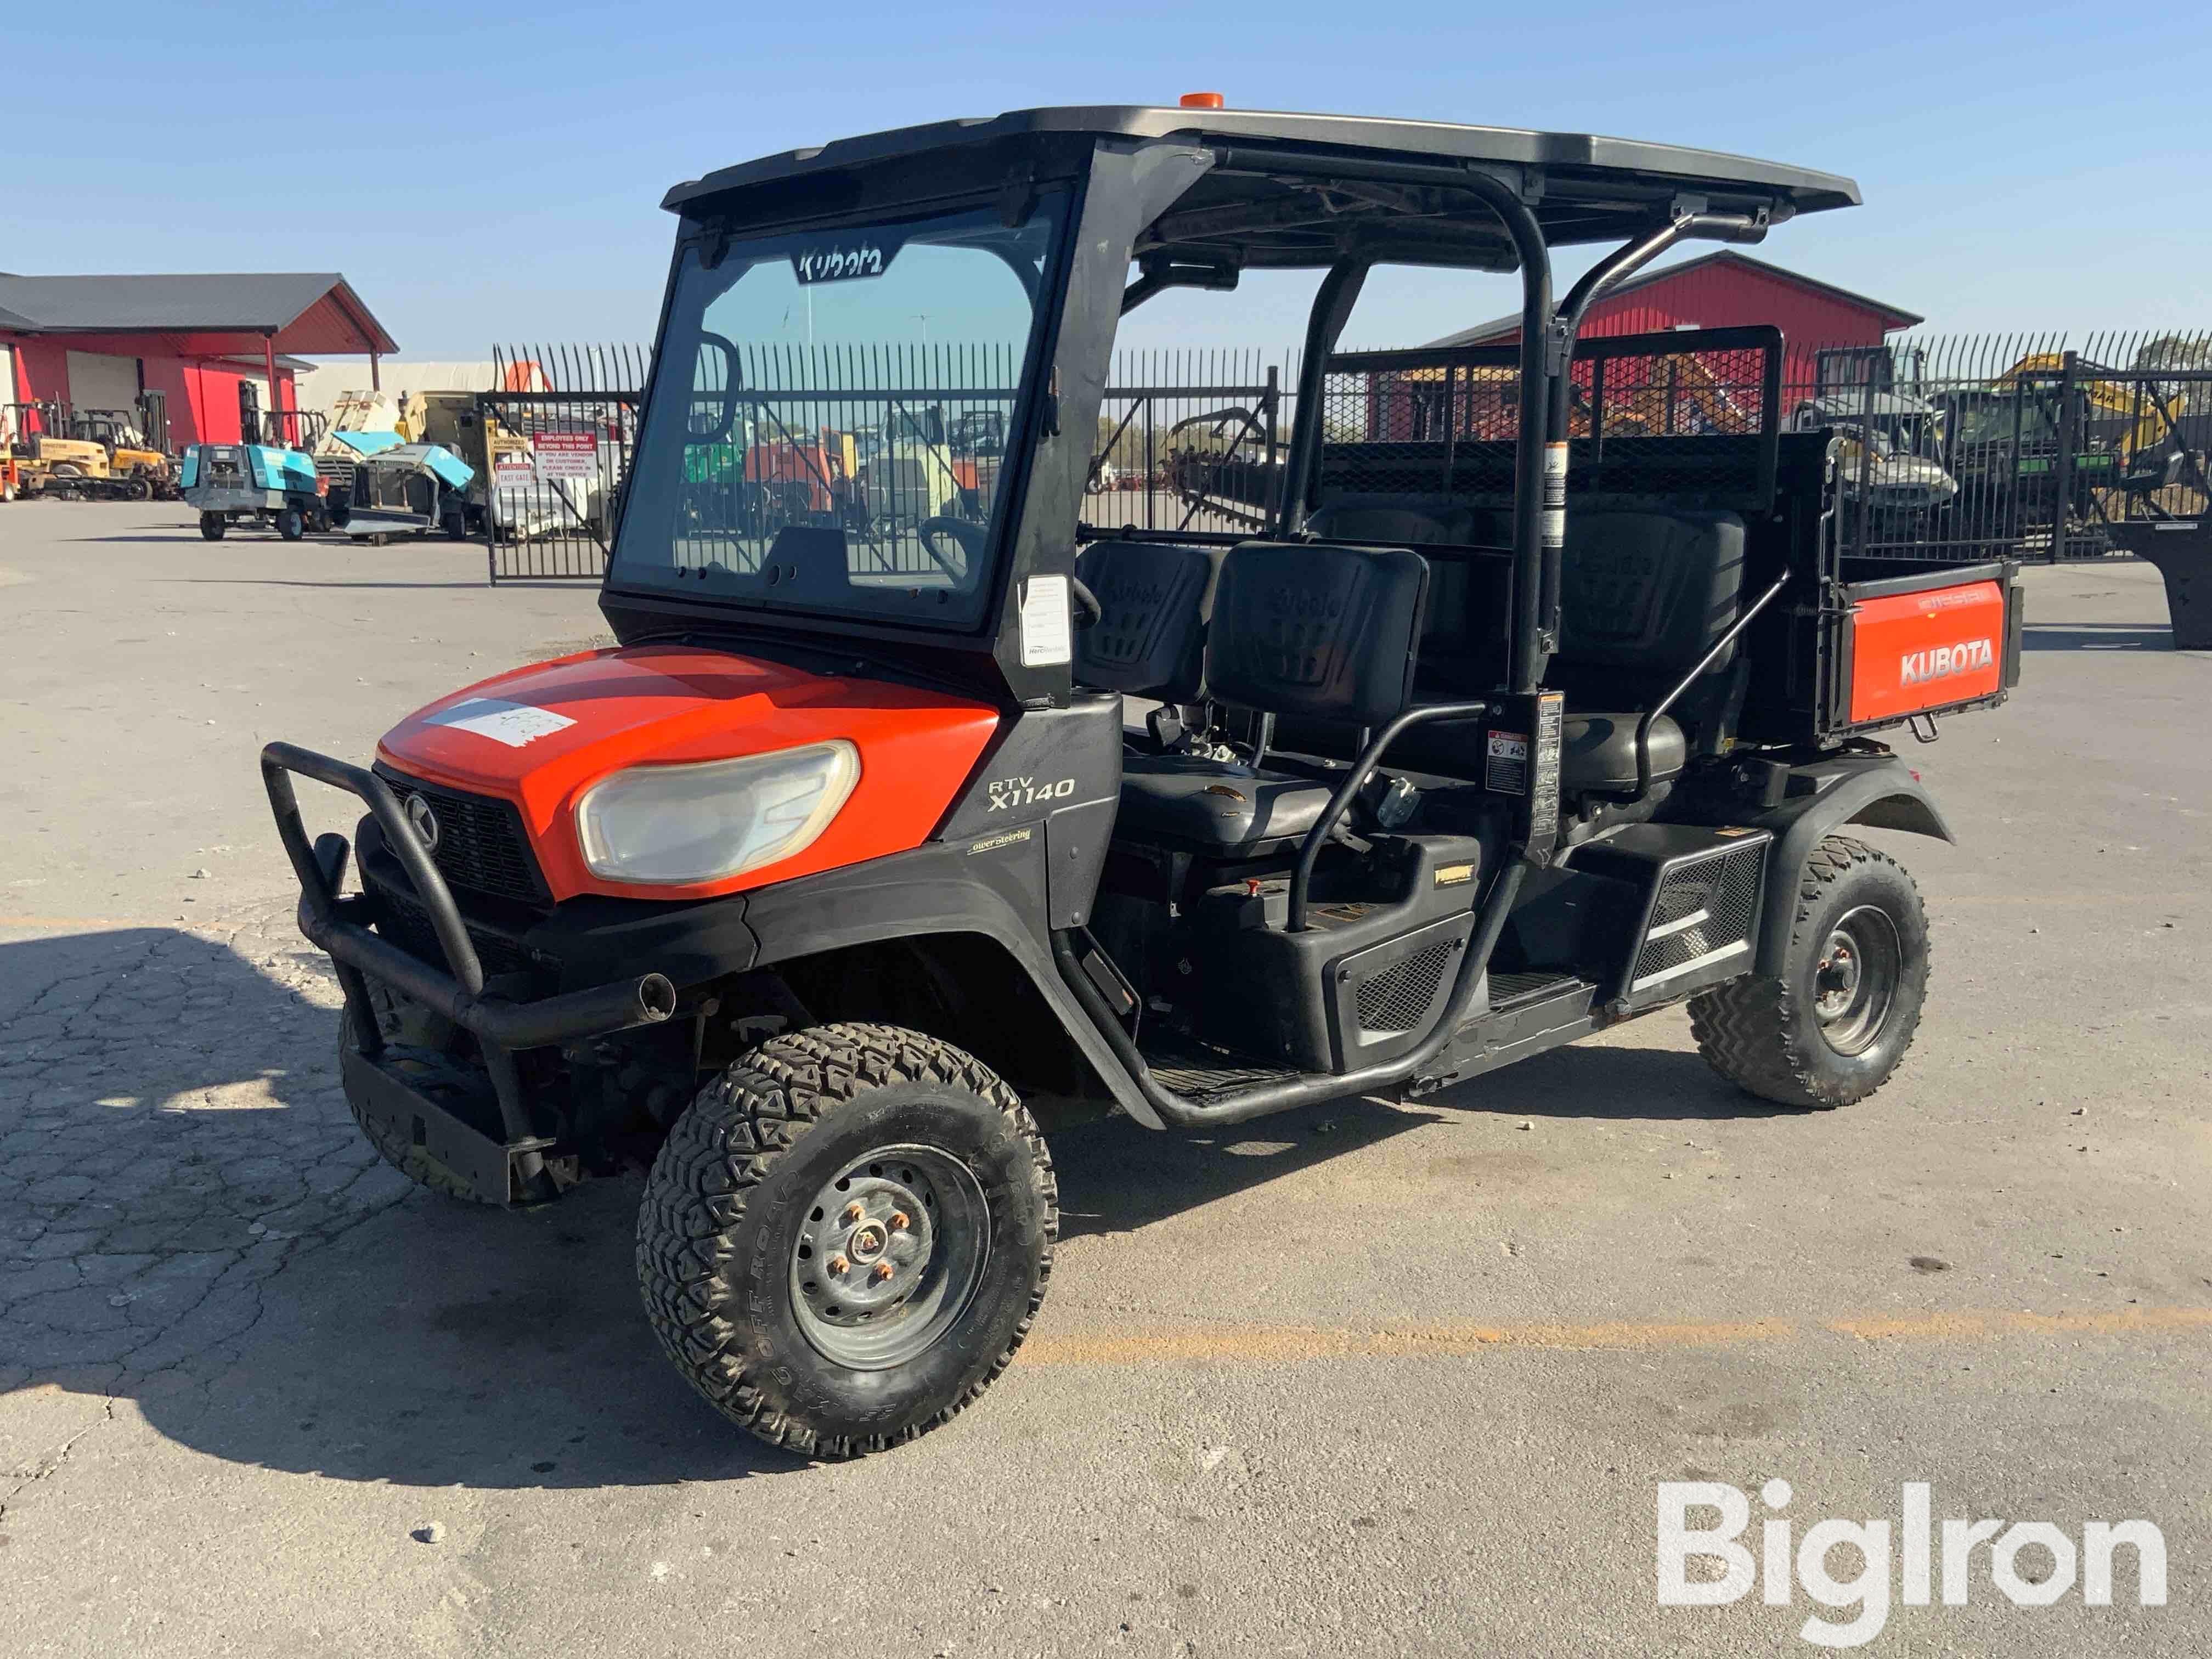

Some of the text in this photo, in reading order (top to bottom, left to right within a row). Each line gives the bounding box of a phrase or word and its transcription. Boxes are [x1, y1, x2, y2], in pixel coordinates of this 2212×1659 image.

[1901, 637, 1993, 685] KUBOTA
[988, 778, 1075, 812] X1140
[989, 776, 1034, 793] RTV
